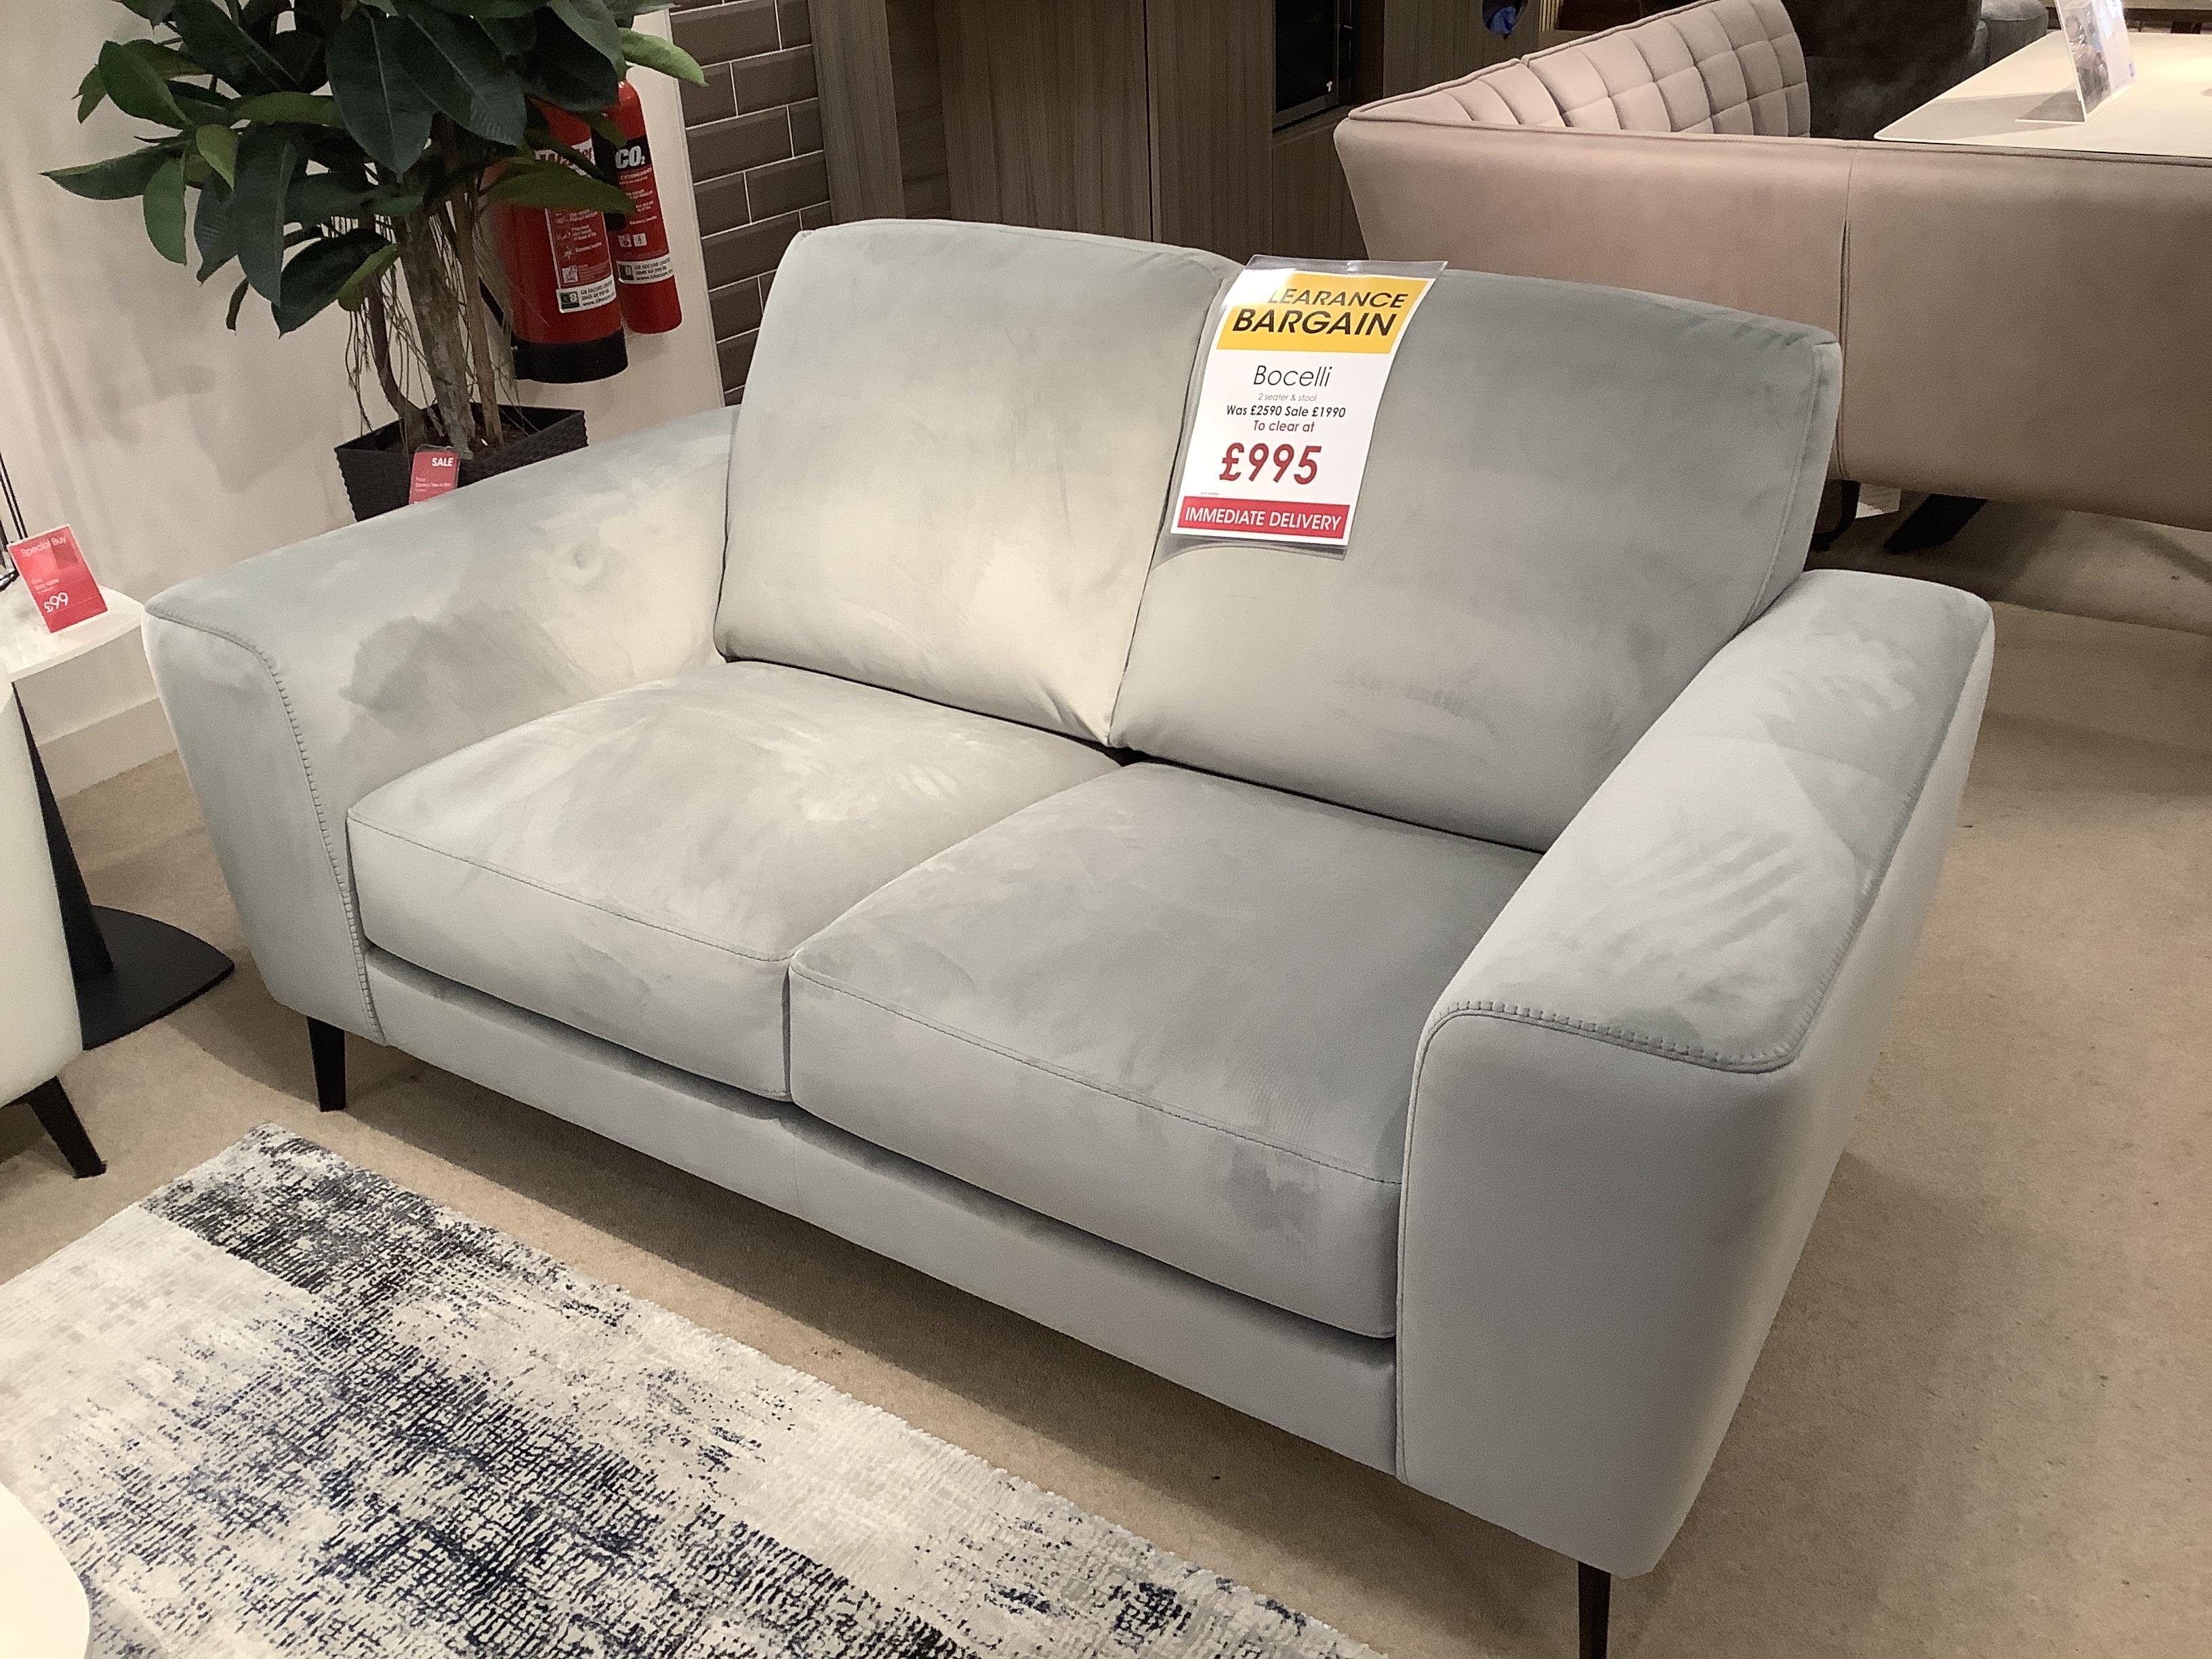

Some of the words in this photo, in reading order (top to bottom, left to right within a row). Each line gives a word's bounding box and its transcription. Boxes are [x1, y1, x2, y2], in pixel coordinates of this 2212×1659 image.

[1267, 288, 1409, 308] LEARANCE
[1232, 308, 1397, 336] BARGAIN
[1253, 365, 1333, 387] Bocelli
[1258, 392, 1264, 401] 2
[1264, 393, 1289, 401] seater
[1290, 394, 1296, 402] &
[1298, 394, 1317, 402] stool
[1226, 405, 1248, 416] Was
[1250, 405, 1282, 416] £2590
[1285, 406, 1309, 417] Sale
[1311, 407, 1347, 418] £1990
[1254, 419, 1265, 431] To
[1269, 420, 1300, 432] clear
[1303, 422, 1315, 432] at
[432, 457, 454, 467] SALE
[1218, 442, 1322, 485] £995
[1185, 506, 1267, 527] IMMEDIATE
[1269, 511, 1343, 532] DELIVERY
[20, 539, 52, 558] Special
[50, 535, 66, 546] Buy
[43, 592, 68, 613] £99
